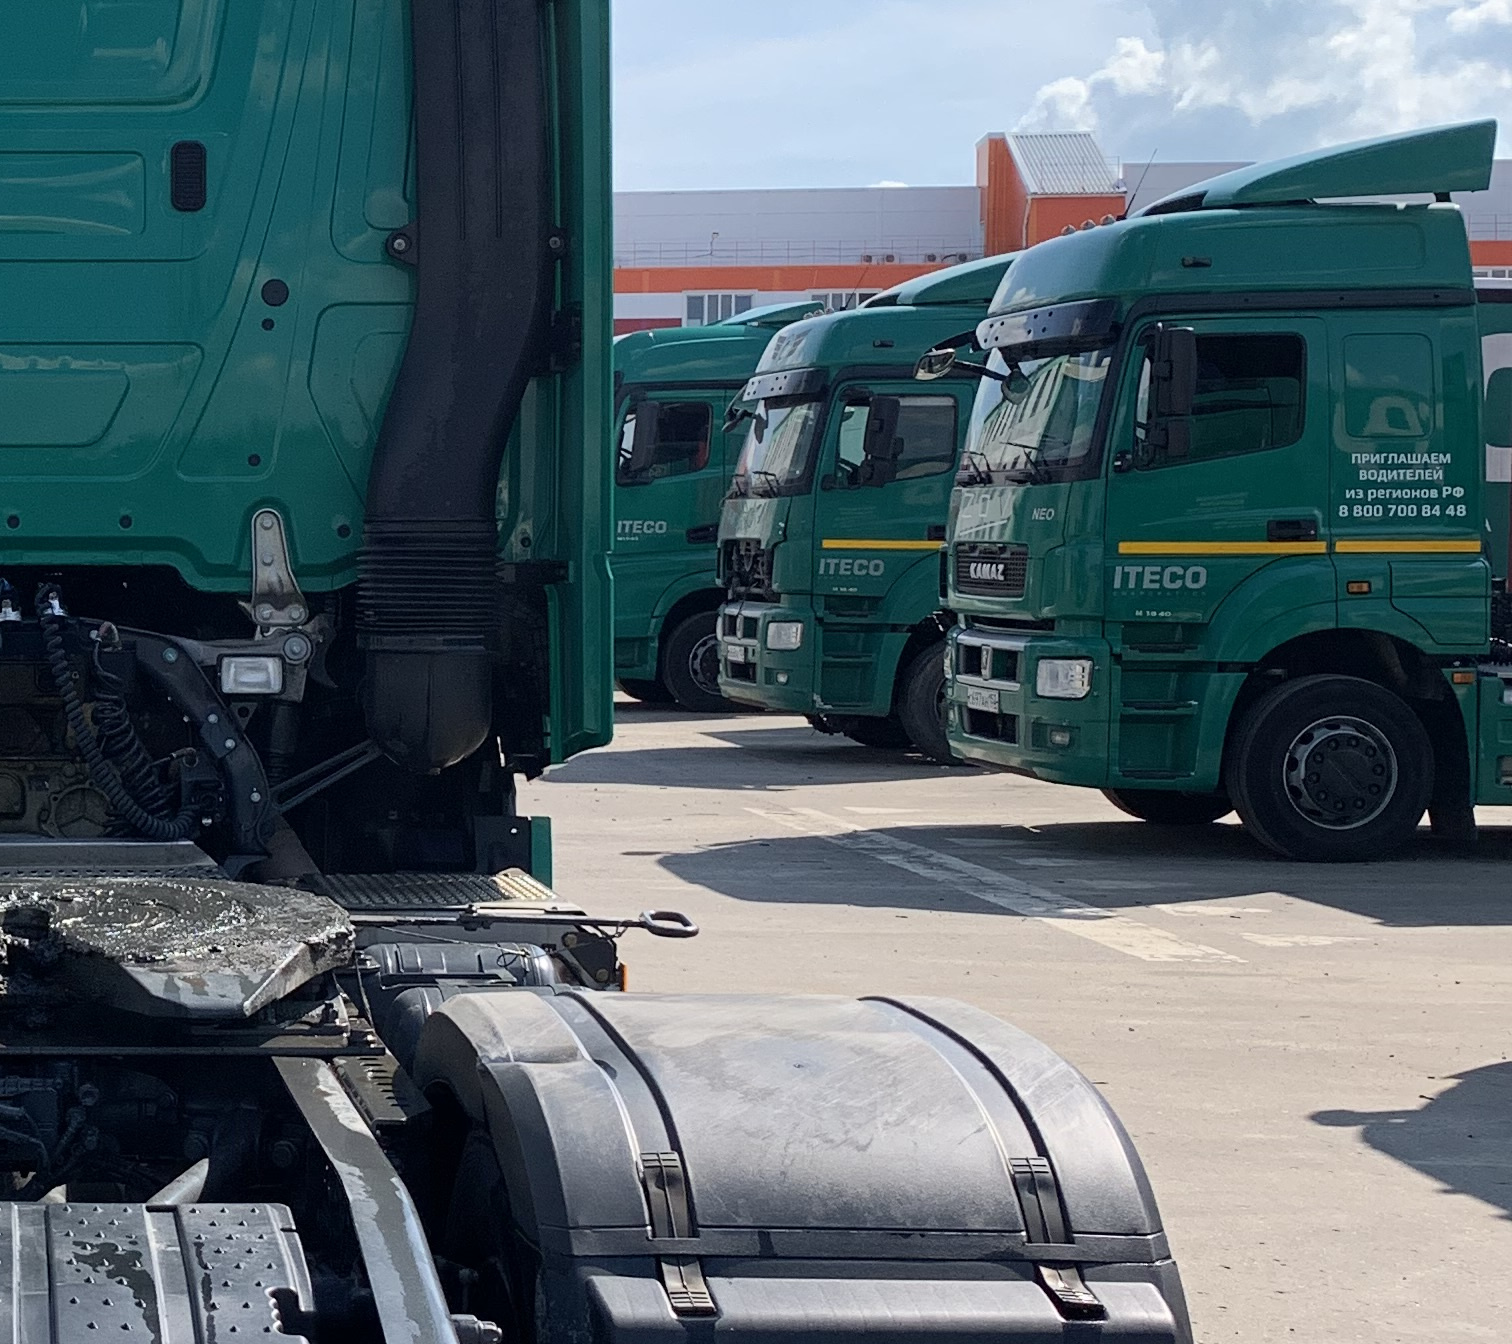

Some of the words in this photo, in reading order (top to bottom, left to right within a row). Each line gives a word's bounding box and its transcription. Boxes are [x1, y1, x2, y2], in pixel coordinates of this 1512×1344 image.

[1351, 453, 1451, 464] ПРИГЛАШАЕМ
[1359, 467, 1443, 482] ВОДИТЕЛЕЙ
[1345, 489, 1364, 498] из
[1367, 489, 1438, 501] регионов
[1442, 486, 1464, 498] РФ
[1032, 508, 1055, 520] NEO
[1338, 505, 1348, 517] 8
[1352, 505, 1383, 517] 800
[1387, 505, 1417, 517] 700
[1421, 505, 1440, 517] 84
[1445, 505, 1466, 517] 48
[617, 520, 667, 534] ITECO
[818, 558, 885, 576] ITECO
[969, 562, 1005, 581] KAMAZ
[1113, 566, 1207, 589] ITECO
